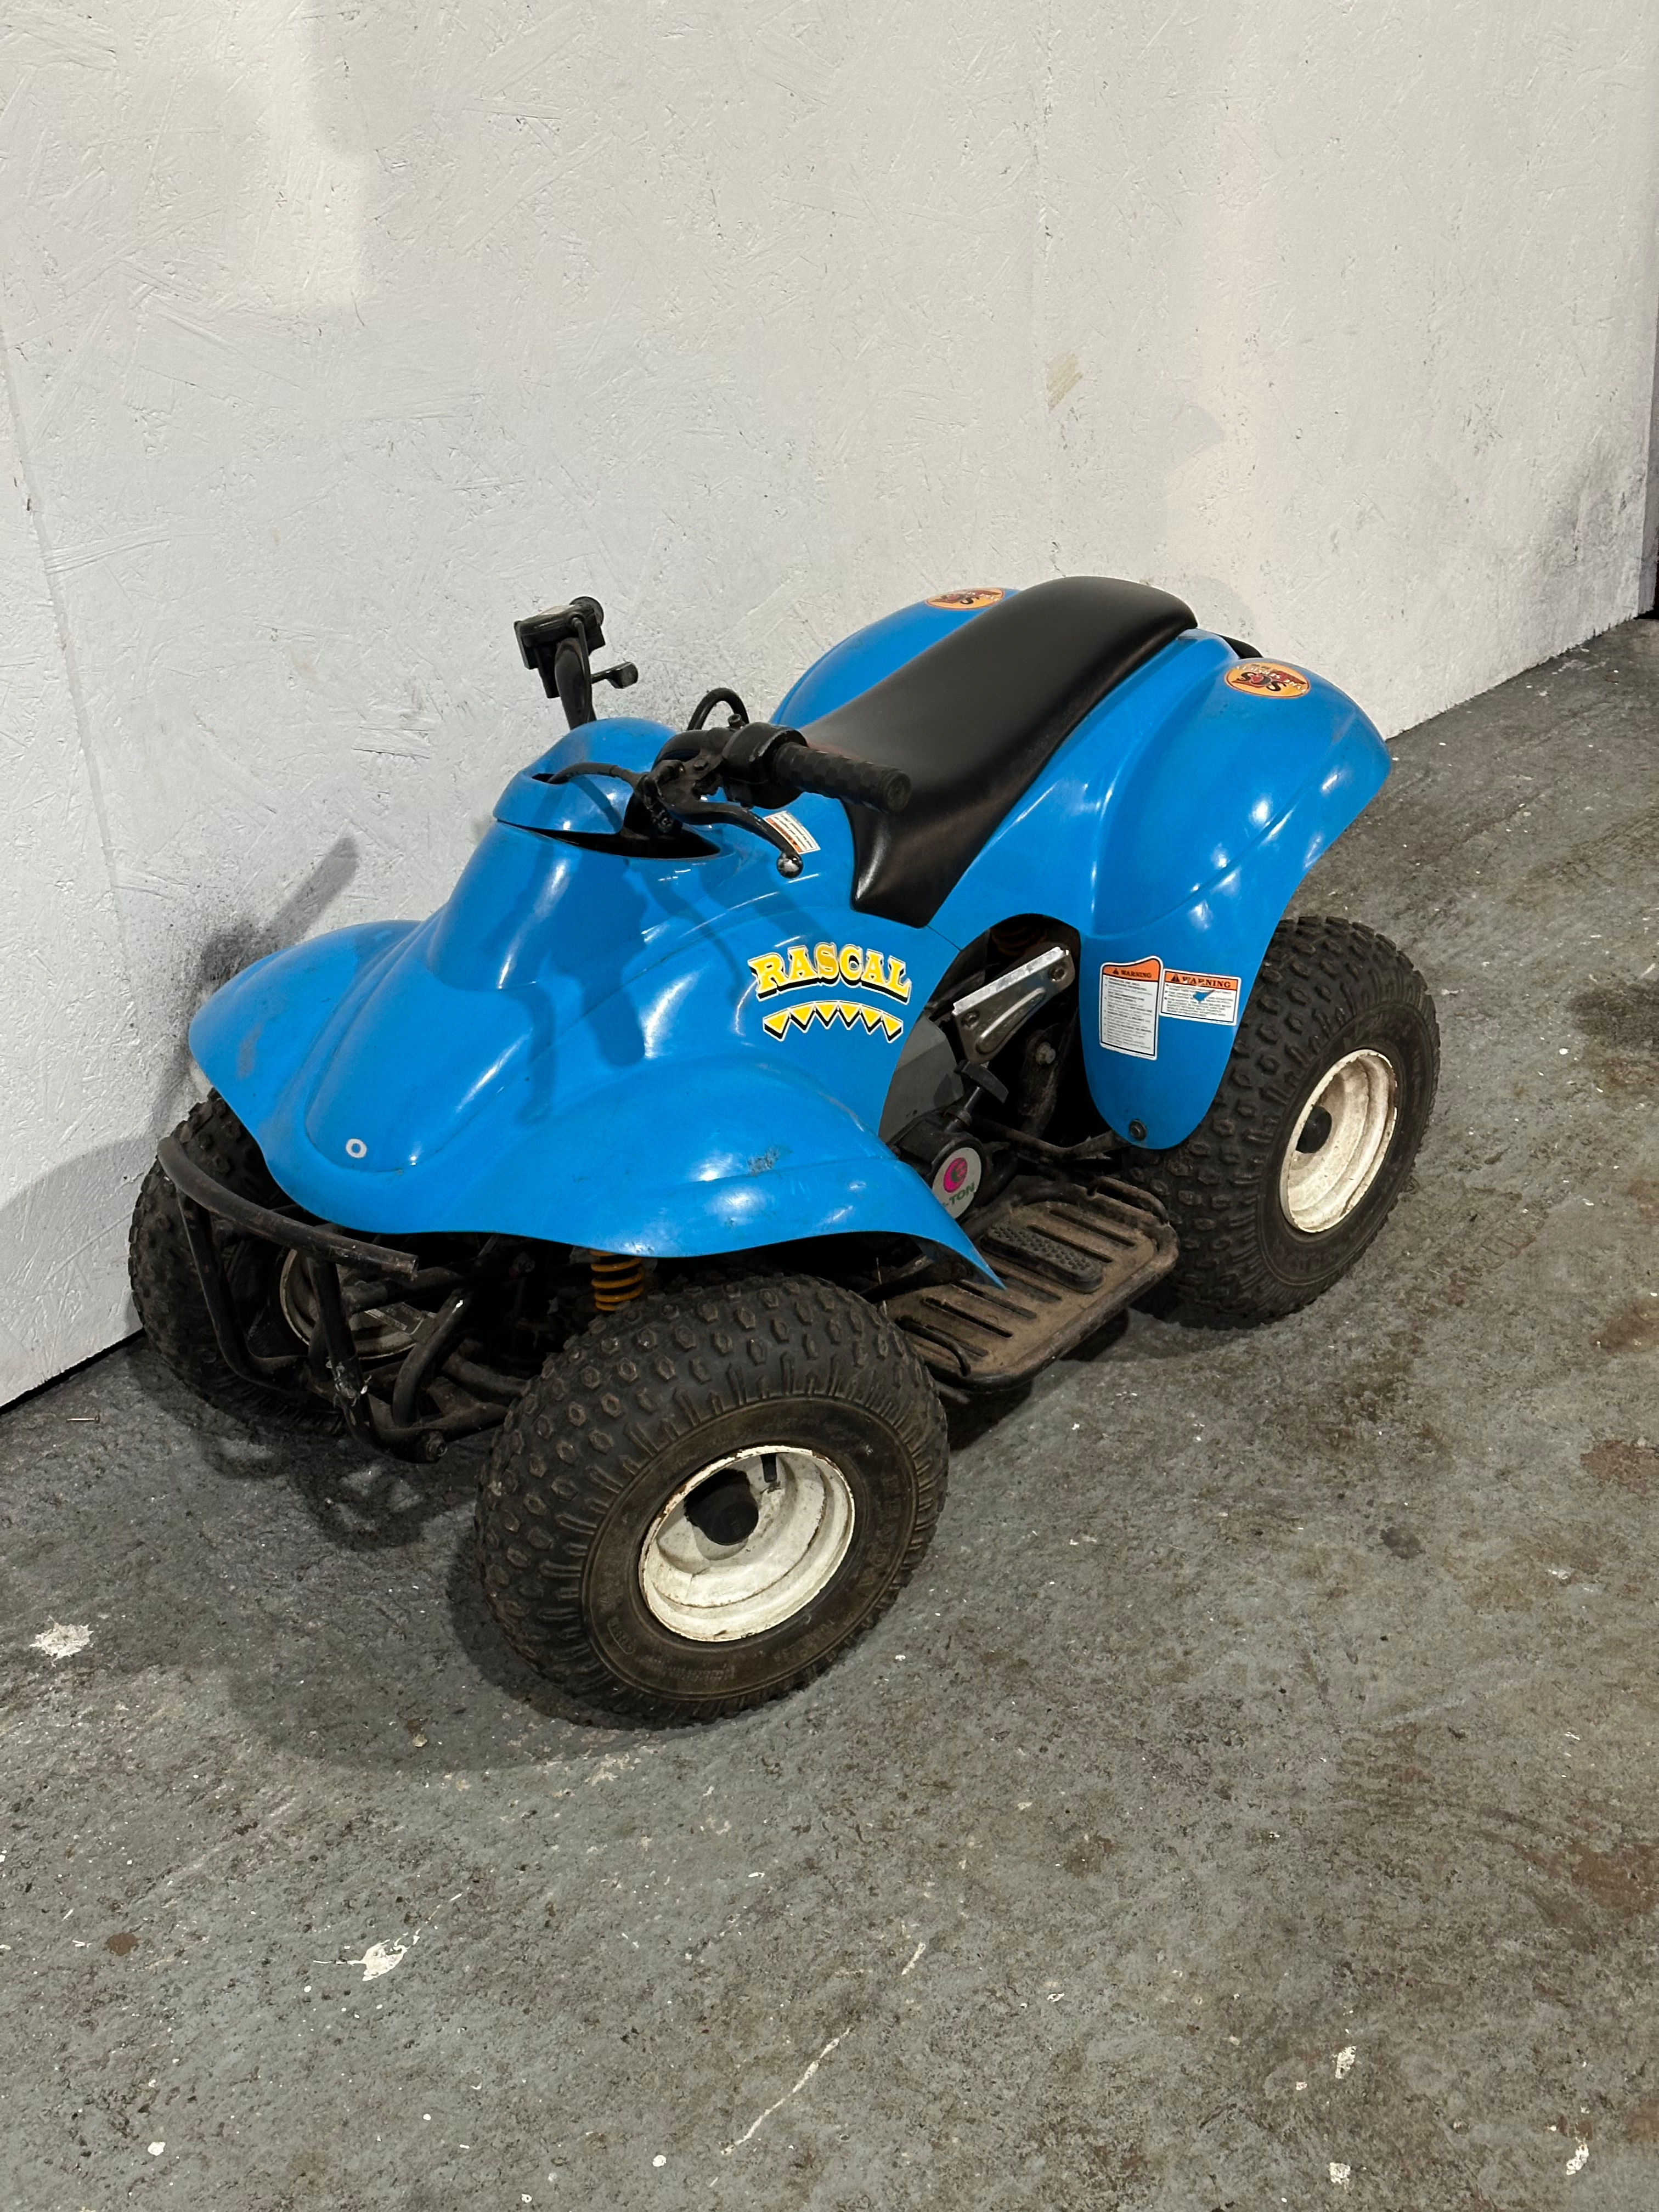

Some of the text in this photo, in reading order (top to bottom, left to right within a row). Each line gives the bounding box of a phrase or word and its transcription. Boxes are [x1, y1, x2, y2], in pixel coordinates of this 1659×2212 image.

[748, 942, 912, 1005] RASCAL
[1121, 970, 1152, 978] WARNING
[1182, 977, 1231, 988] WARNING
